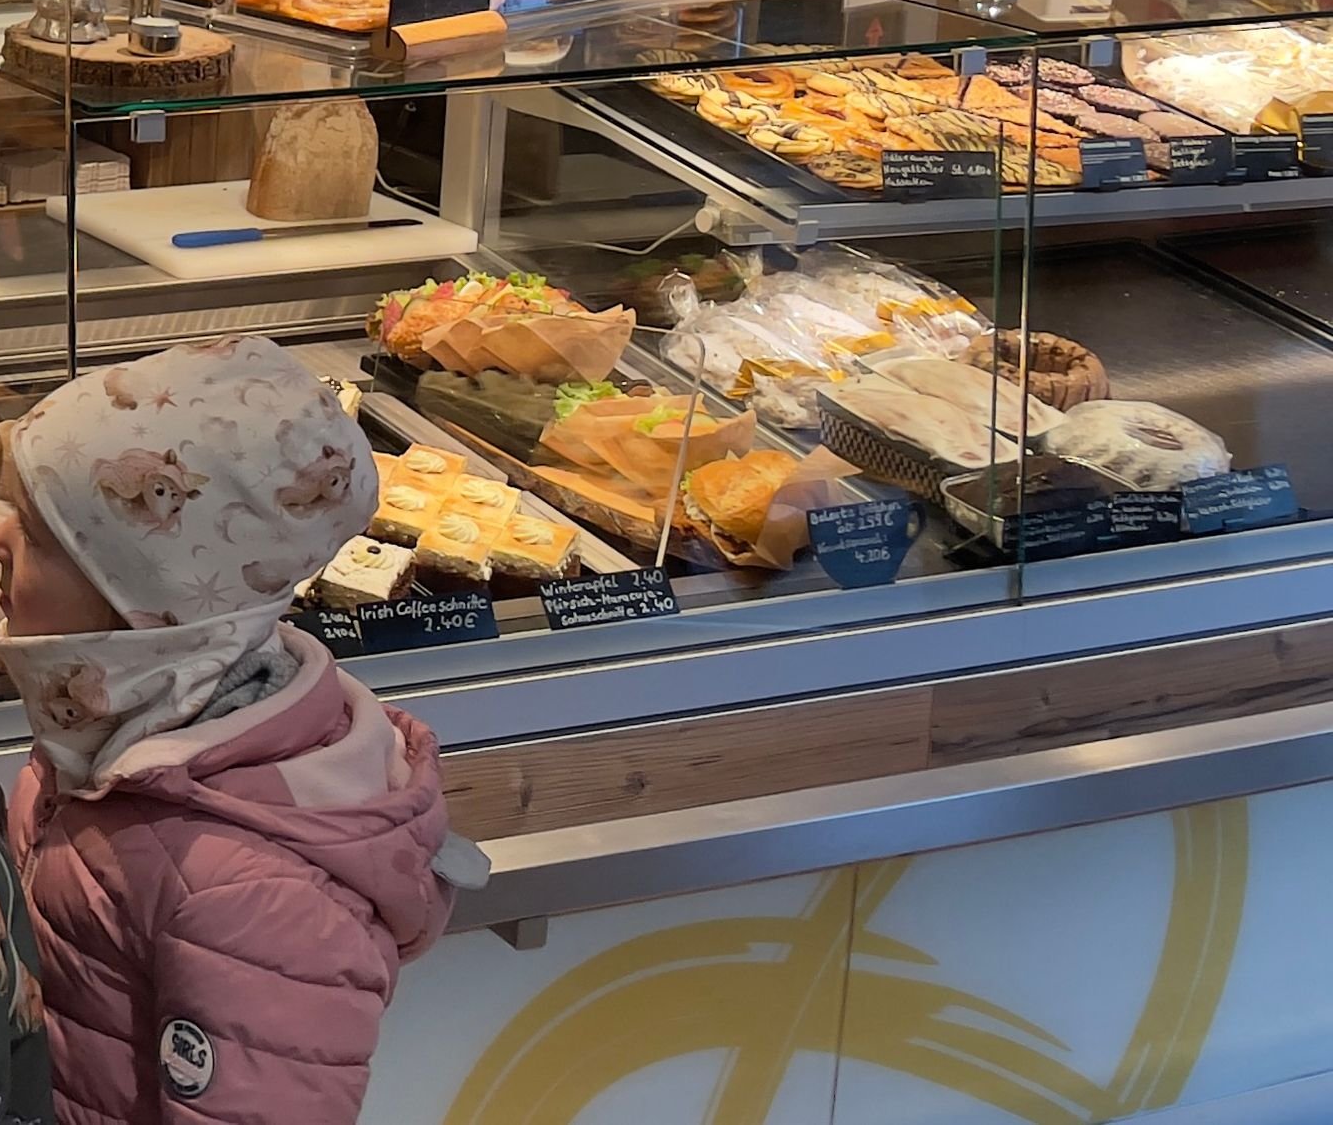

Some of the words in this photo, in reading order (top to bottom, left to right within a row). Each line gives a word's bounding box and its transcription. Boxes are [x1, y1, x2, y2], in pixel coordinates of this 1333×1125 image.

[541, 575, 618, 596] Winterapfel
[631, 570, 663, 586] 2.40
[639, 597, 673, 613] 2.40
[360, 606, 394, 621] Irish
